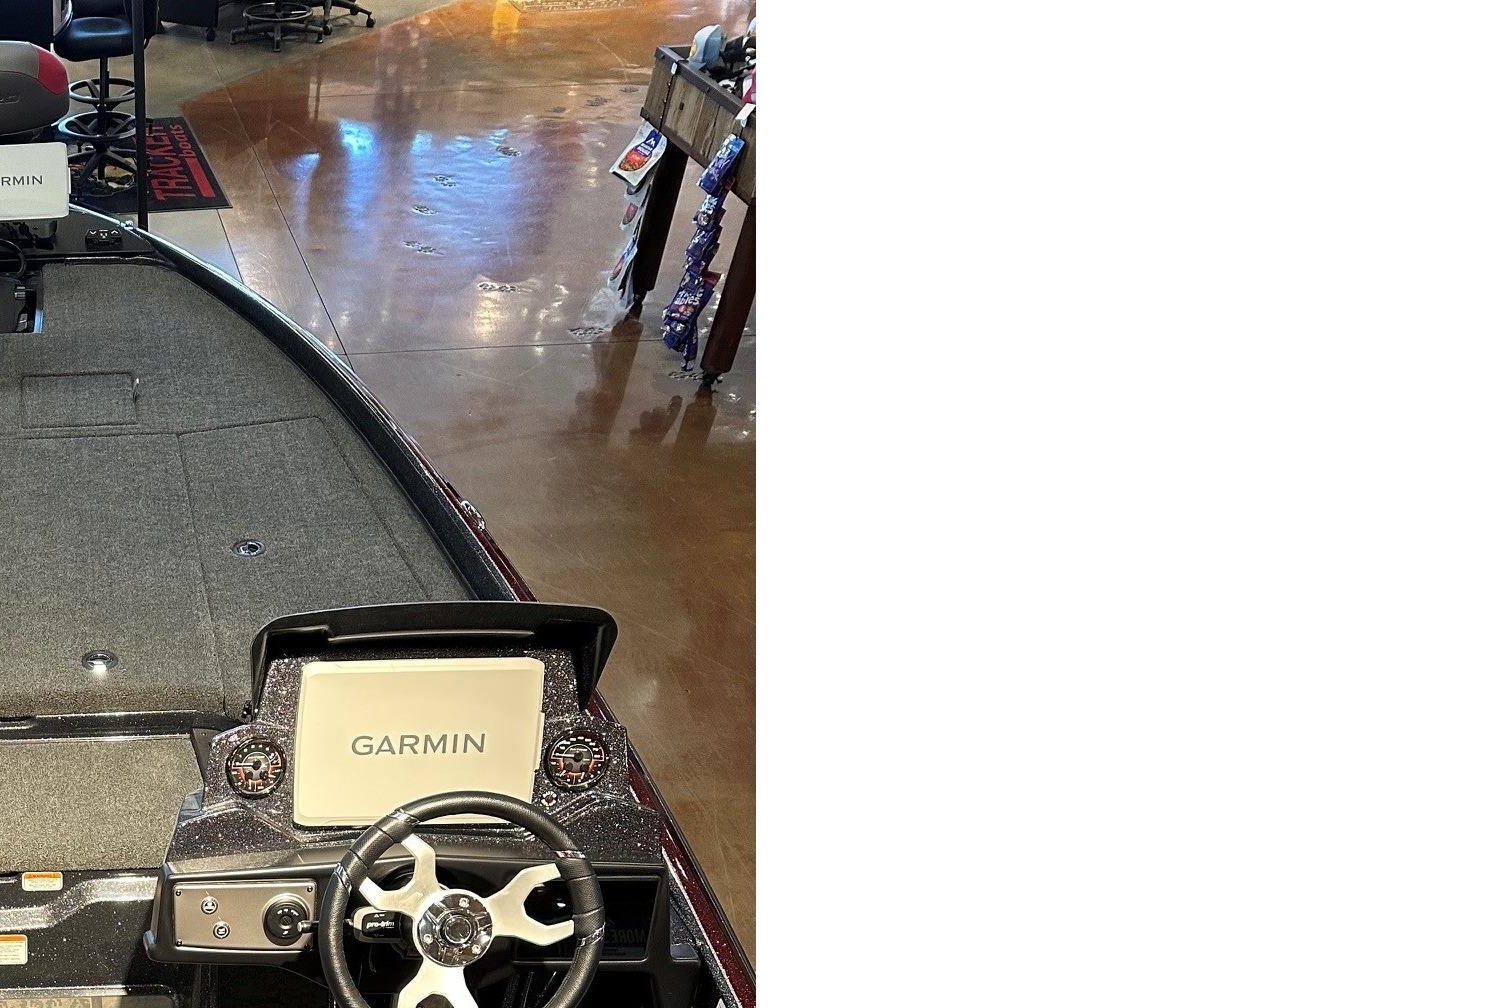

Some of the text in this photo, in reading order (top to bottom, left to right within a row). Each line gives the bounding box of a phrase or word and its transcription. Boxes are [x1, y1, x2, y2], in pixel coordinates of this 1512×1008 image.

[169, 123, 198, 159] boats
[350, 732, 487, 756] GARMIN
[366, 920, 395, 929] pro-trim
